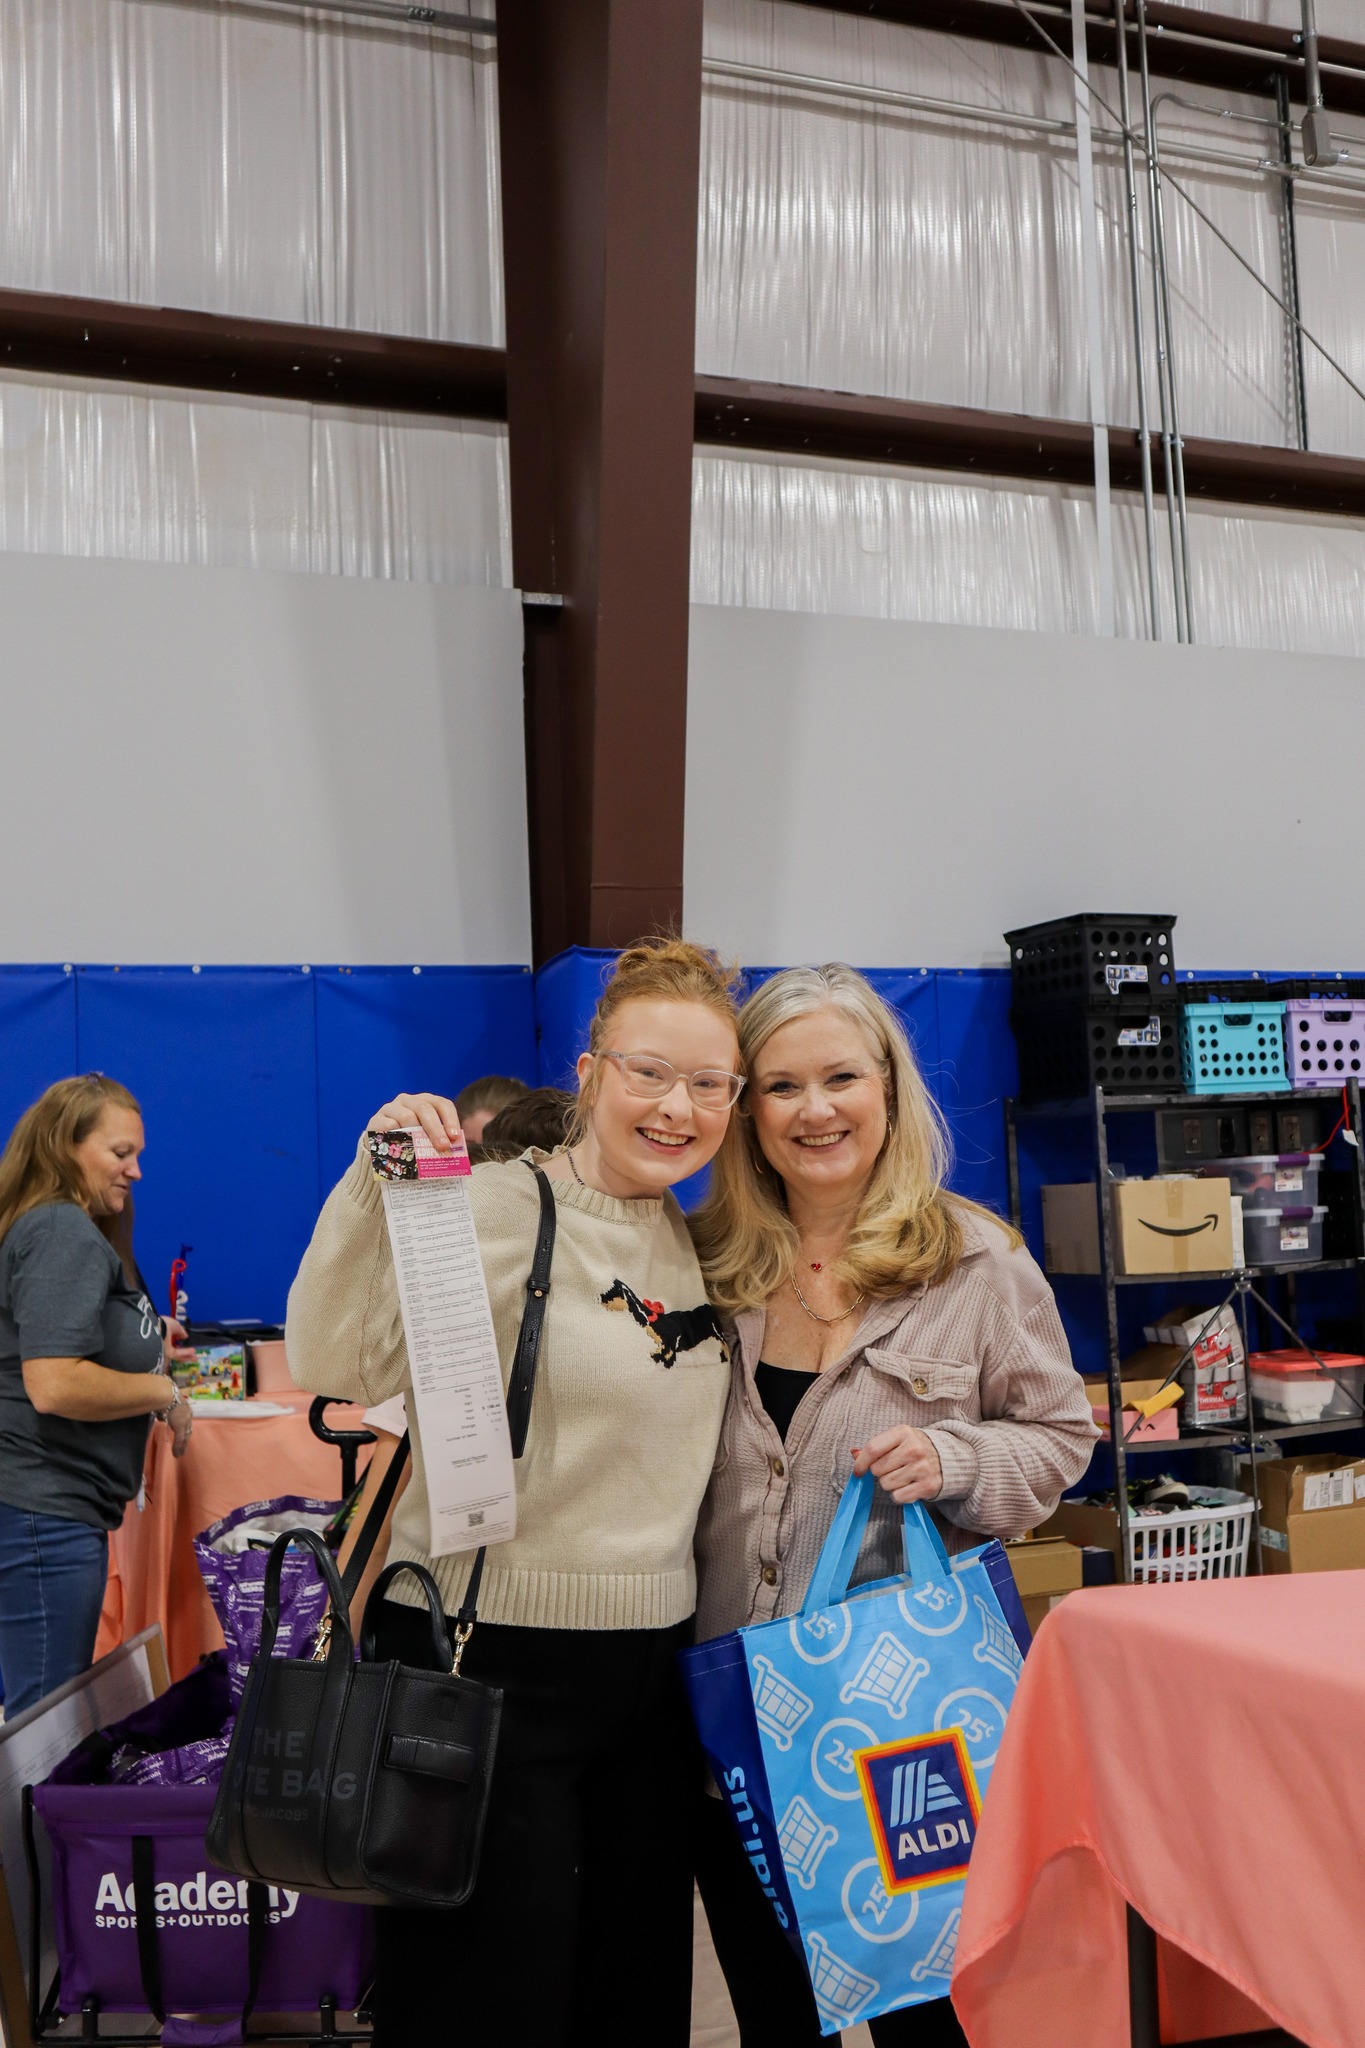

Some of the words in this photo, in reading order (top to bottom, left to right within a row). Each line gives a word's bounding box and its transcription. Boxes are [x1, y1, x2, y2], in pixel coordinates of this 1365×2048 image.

[913, 1582, 954, 1612] 25¢
[803, 1611, 837, 1640] 25¢
[254, 1727, 306, 1758] THE
[824, 1738, 854, 1774] 25
[281, 1768, 357, 1800] BAG
[898, 1819, 971, 1860] ALDI
